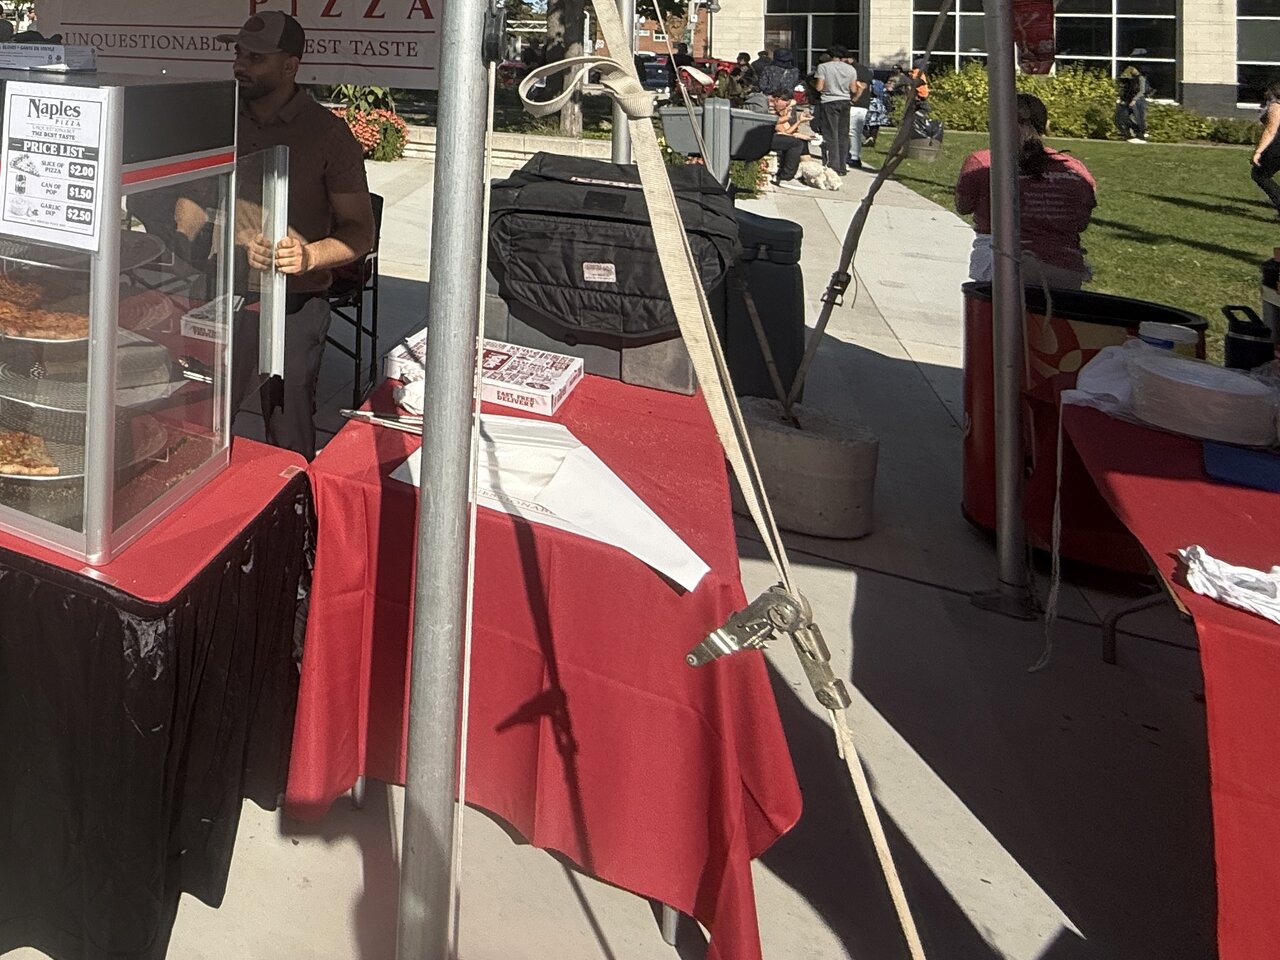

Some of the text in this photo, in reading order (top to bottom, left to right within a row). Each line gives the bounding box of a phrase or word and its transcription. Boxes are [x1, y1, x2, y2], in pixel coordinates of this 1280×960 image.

[303, 38, 342, 55] EST
[349, 40, 419, 58] TASTE
[27, 98, 82, 120] Naples
[54, 118, 82, 127] PIZZA
[58, 133, 76, 141] TASTE
[23, 141, 86, 159] PRICE LIST
[41, 160, 65, 169] SLICE OF
[69, 164, 94, 178] $2.00
[40, 181, 54, 189] CAN
[45, 188, 58, 196] POP
[68, 186, 93, 200] $1.50
[40, 202, 62, 212] GARLIC
[45, 209, 56, 217] DIP
[66, 208, 92, 222] $2.50
[496, 390, 535, 403] FAST FREE
[496, 395, 535, 408] DELIVERY
